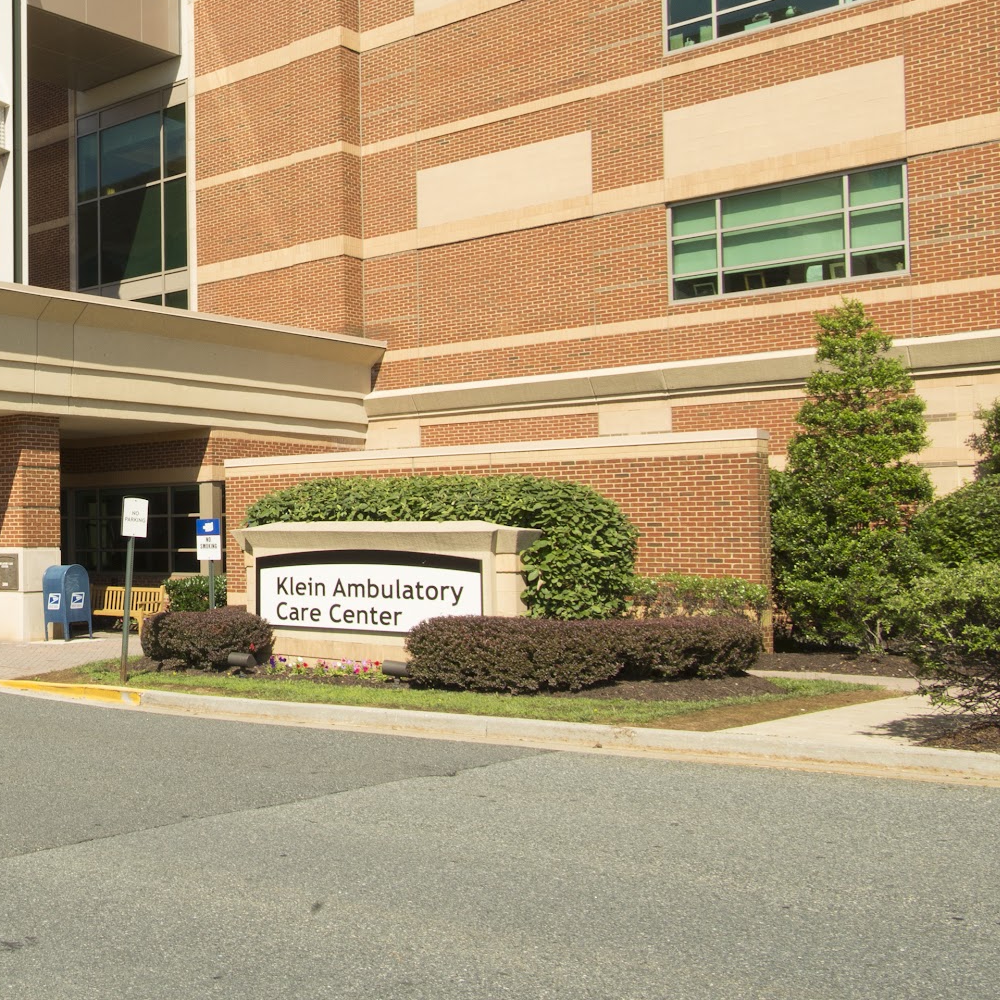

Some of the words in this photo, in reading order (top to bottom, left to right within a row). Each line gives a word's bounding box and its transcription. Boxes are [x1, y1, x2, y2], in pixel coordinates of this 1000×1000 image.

[276, 576, 326, 597] Klein
[332, 577, 464, 606] Ambulatory
[276, 601, 321, 622] Care
[329, 603, 403, 626] Center
